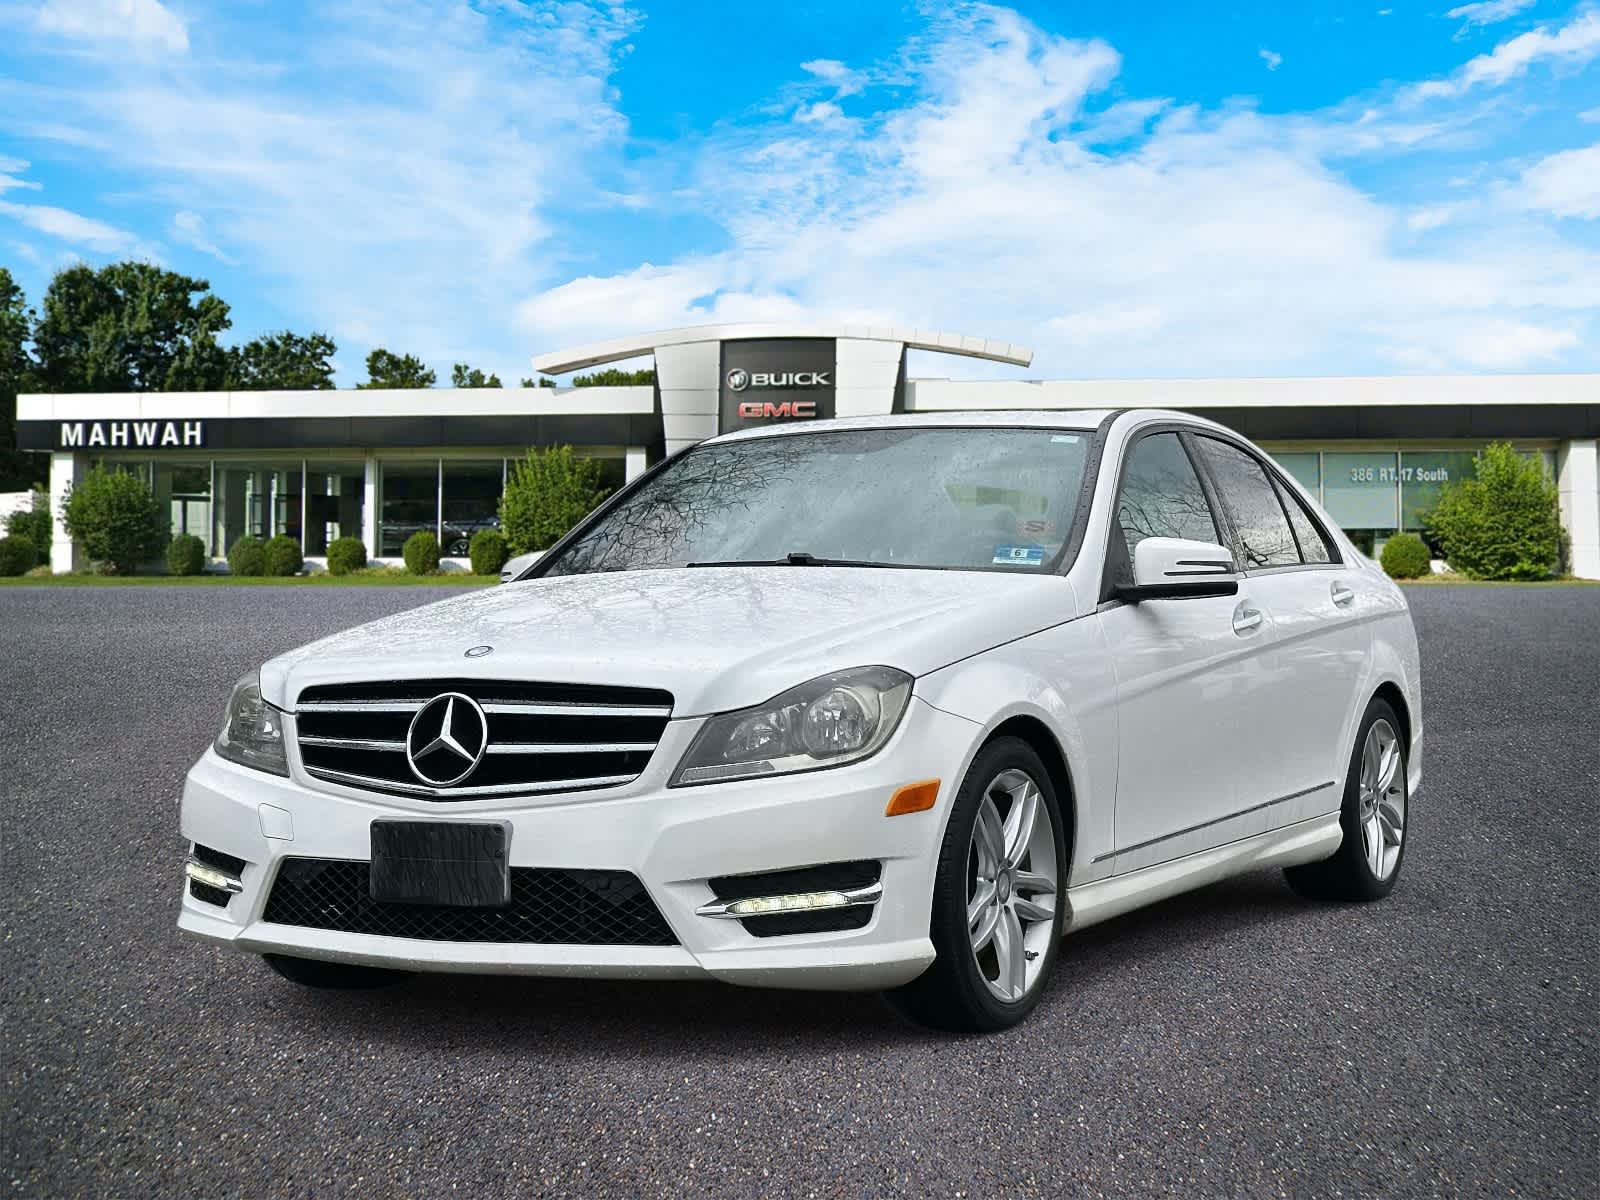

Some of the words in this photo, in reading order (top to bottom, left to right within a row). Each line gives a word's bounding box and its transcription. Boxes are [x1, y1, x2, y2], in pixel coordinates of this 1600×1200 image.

[751, 372, 832, 386] BUICK
[738, 401, 816, 417] GMC
[61, 421, 202, 447] MAHWAH
[1350, 467, 1374, 481] 386
[1400, 468, 1413, 481] 17
[1416, 467, 1449, 481] South
[1014, 549, 1022, 557] 6
